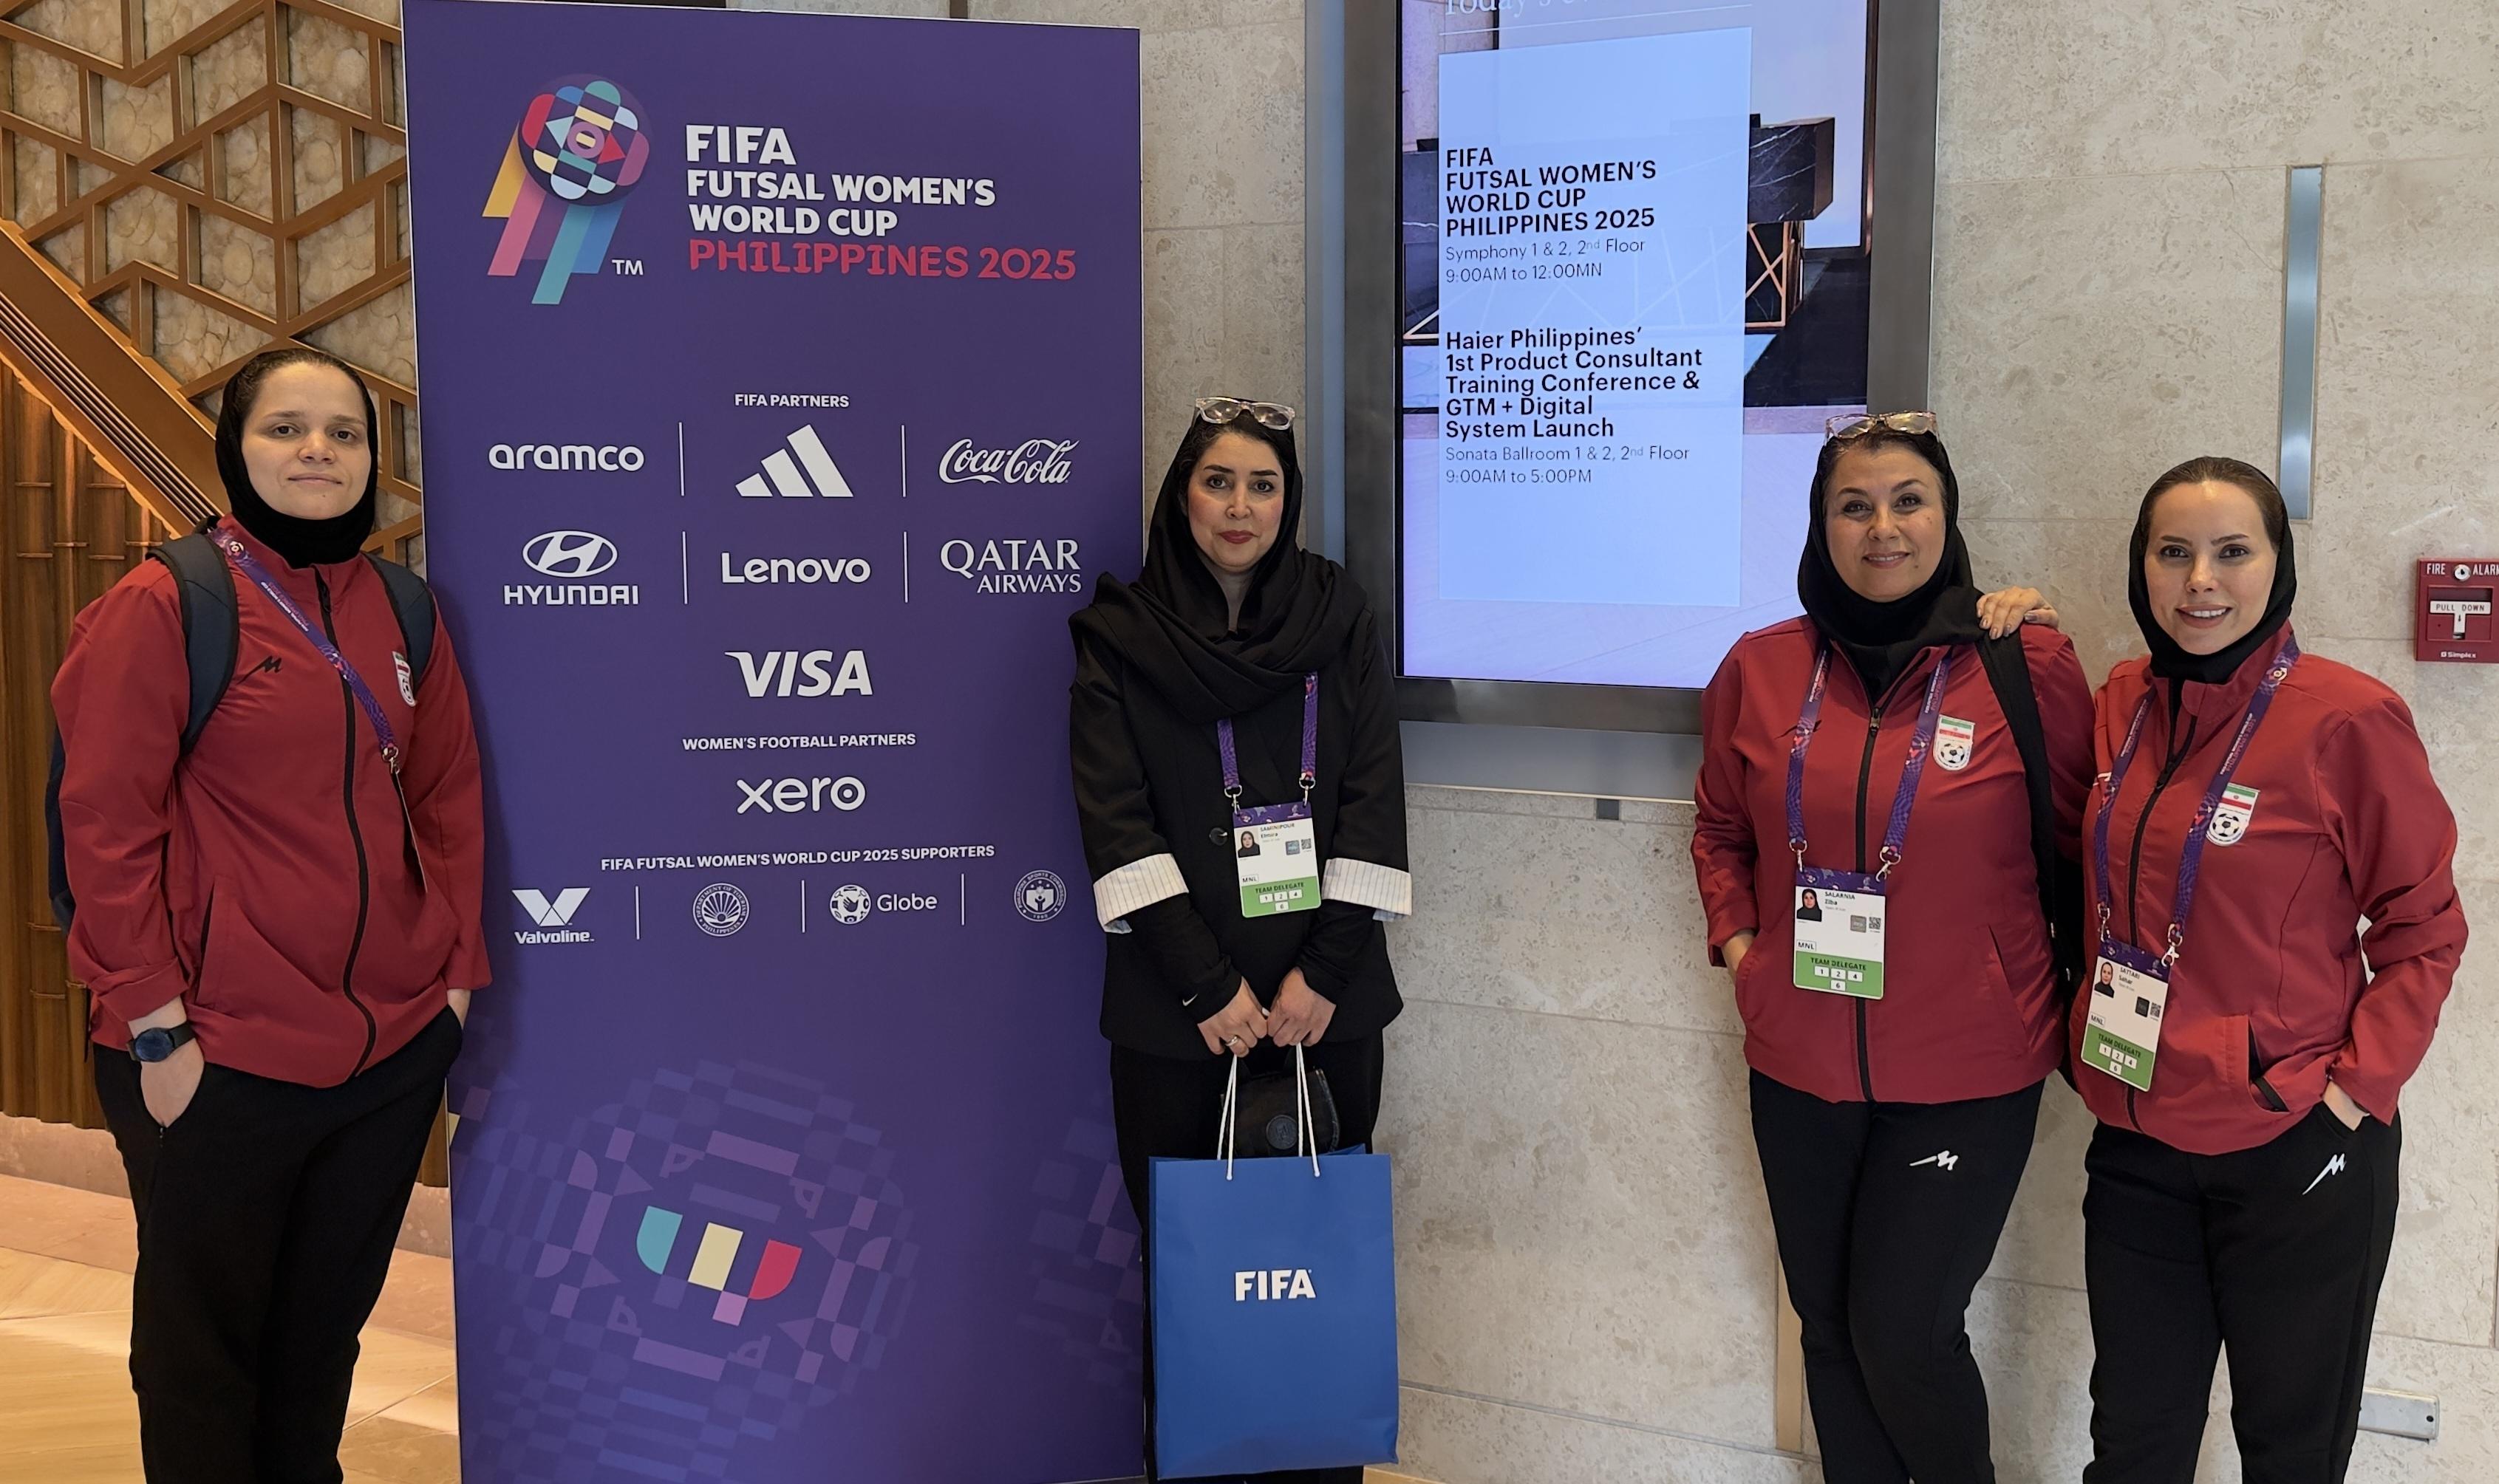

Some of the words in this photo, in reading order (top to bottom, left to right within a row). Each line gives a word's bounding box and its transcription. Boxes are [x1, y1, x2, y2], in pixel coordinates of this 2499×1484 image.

[686, 124, 797, 165] FIFA
[1448, 148, 1493, 168] FIFA
[1448, 168, 1532, 191] FUTSAL
[1539, 160, 1655, 185] WOMEN'S
[687, 169, 825, 201] FUTSAL
[831, 174, 996, 207] WOMEN'S
[1447, 192, 1530, 213] WORLD
[1538, 188, 1585, 208] CUP
[688, 204, 821, 235] WORLD
[827, 208, 897, 237] CUP
[1448, 212, 1587, 237] PHILIPPINES
[1595, 208, 1654, 229] 2025
[690, 239, 969, 278] PHILIPPINES
[978, 247, 1075, 280] 2025
[1447, 244, 1527, 261] Symphony
[1533, 243, 1537, 256] 1
[1544, 242, 1552, 256] &
[1558, 241, 1572, 256] 2,
[1578, 239, 1600, 254] 2nd
[1606, 238, 1646, 253] Floor
[612, 259, 643, 275] TM
[1447, 267, 1506, 283] 9:00AM
[1512, 267, 1527, 280] to
[1533, 263, 1601, 279] 12:00MN
[1447, 331, 1504, 349] Haier
[1511, 326, 1641, 351] Philippines'
[1447, 354, 1473, 372] 1st
[1482, 351, 1567, 371] Product
[1575, 348, 1702, 369] Consultant
[1447, 375, 1533, 397] Training
[1542, 373, 1676, 392] Conference
[1683, 371, 1699, 389] &
[734, 393, 768, 406] FIFA
[771, 394, 850, 408] PARTNERS
[1447, 398, 1495, 416] GTM
[1502, 403, 1513, 413] +
[1521, 395, 1592, 419] Digital
[1446, 421, 1525, 442] System
[1534, 417, 1614, 437] Launch
[489, 444, 645, 472] aramco
[938, 438, 1079, 484] Coca-Cola
[1446, 447, 1497, 461] Sonata
[1503, 446, 1570, 460] Ballroom
[1576, 447, 1581, 459] 1
[1587, 447, 1598, 459] &
[1603, 447, 1615, 462] 2,
[1621, 445, 1643, 459] 2nd
[1650, 445, 1690, 459] Floor
[1446, 470, 1505, 483] 9:00AM
[1512, 470, 1525, 483] to
[1531, 469, 1591, 482] 5:00PM
[721, 552, 871, 584] Lenovo
[940, 538, 1080, 579] QATAR
[2427, 564, 2445, 575] FIRE
[505, 584, 639, 606] HYUNDAI
[978, 574, 1082, 593] AIRWAYS
[725, 649, 873, 698] VISA
[683, 737, 756, 750] WOMEN'S
[759, 736, 836, 749] FOOTBALL
[840, 733, 916, 746] PARTNERS
[737, 776, 867, 813] xero
[601, 858, 634, 870] FIFA
[637, 857, 695, 869] FUTSAL
[697, 853, 769, 866] WOMEN'S
[773, 852, 828, 864] WORLD
[831, 851, 860, 863] CUP
[863, 849, 899, 861] 2025
[901, 845, 994, 859] SUPPORTERS
[1274, 882, 1304, 891] DELEGATE
[876, 893, 937, 912] Globe
[1799, 942, 1814, 950] MNL
[1810, 957, 1830, 965] TEAM
[1831, 960, 1867, 971] DELEGATE
[2099, 1033, 2113, 1044] TEAM
[1234, 1268, 1317, 1302] FIFA
